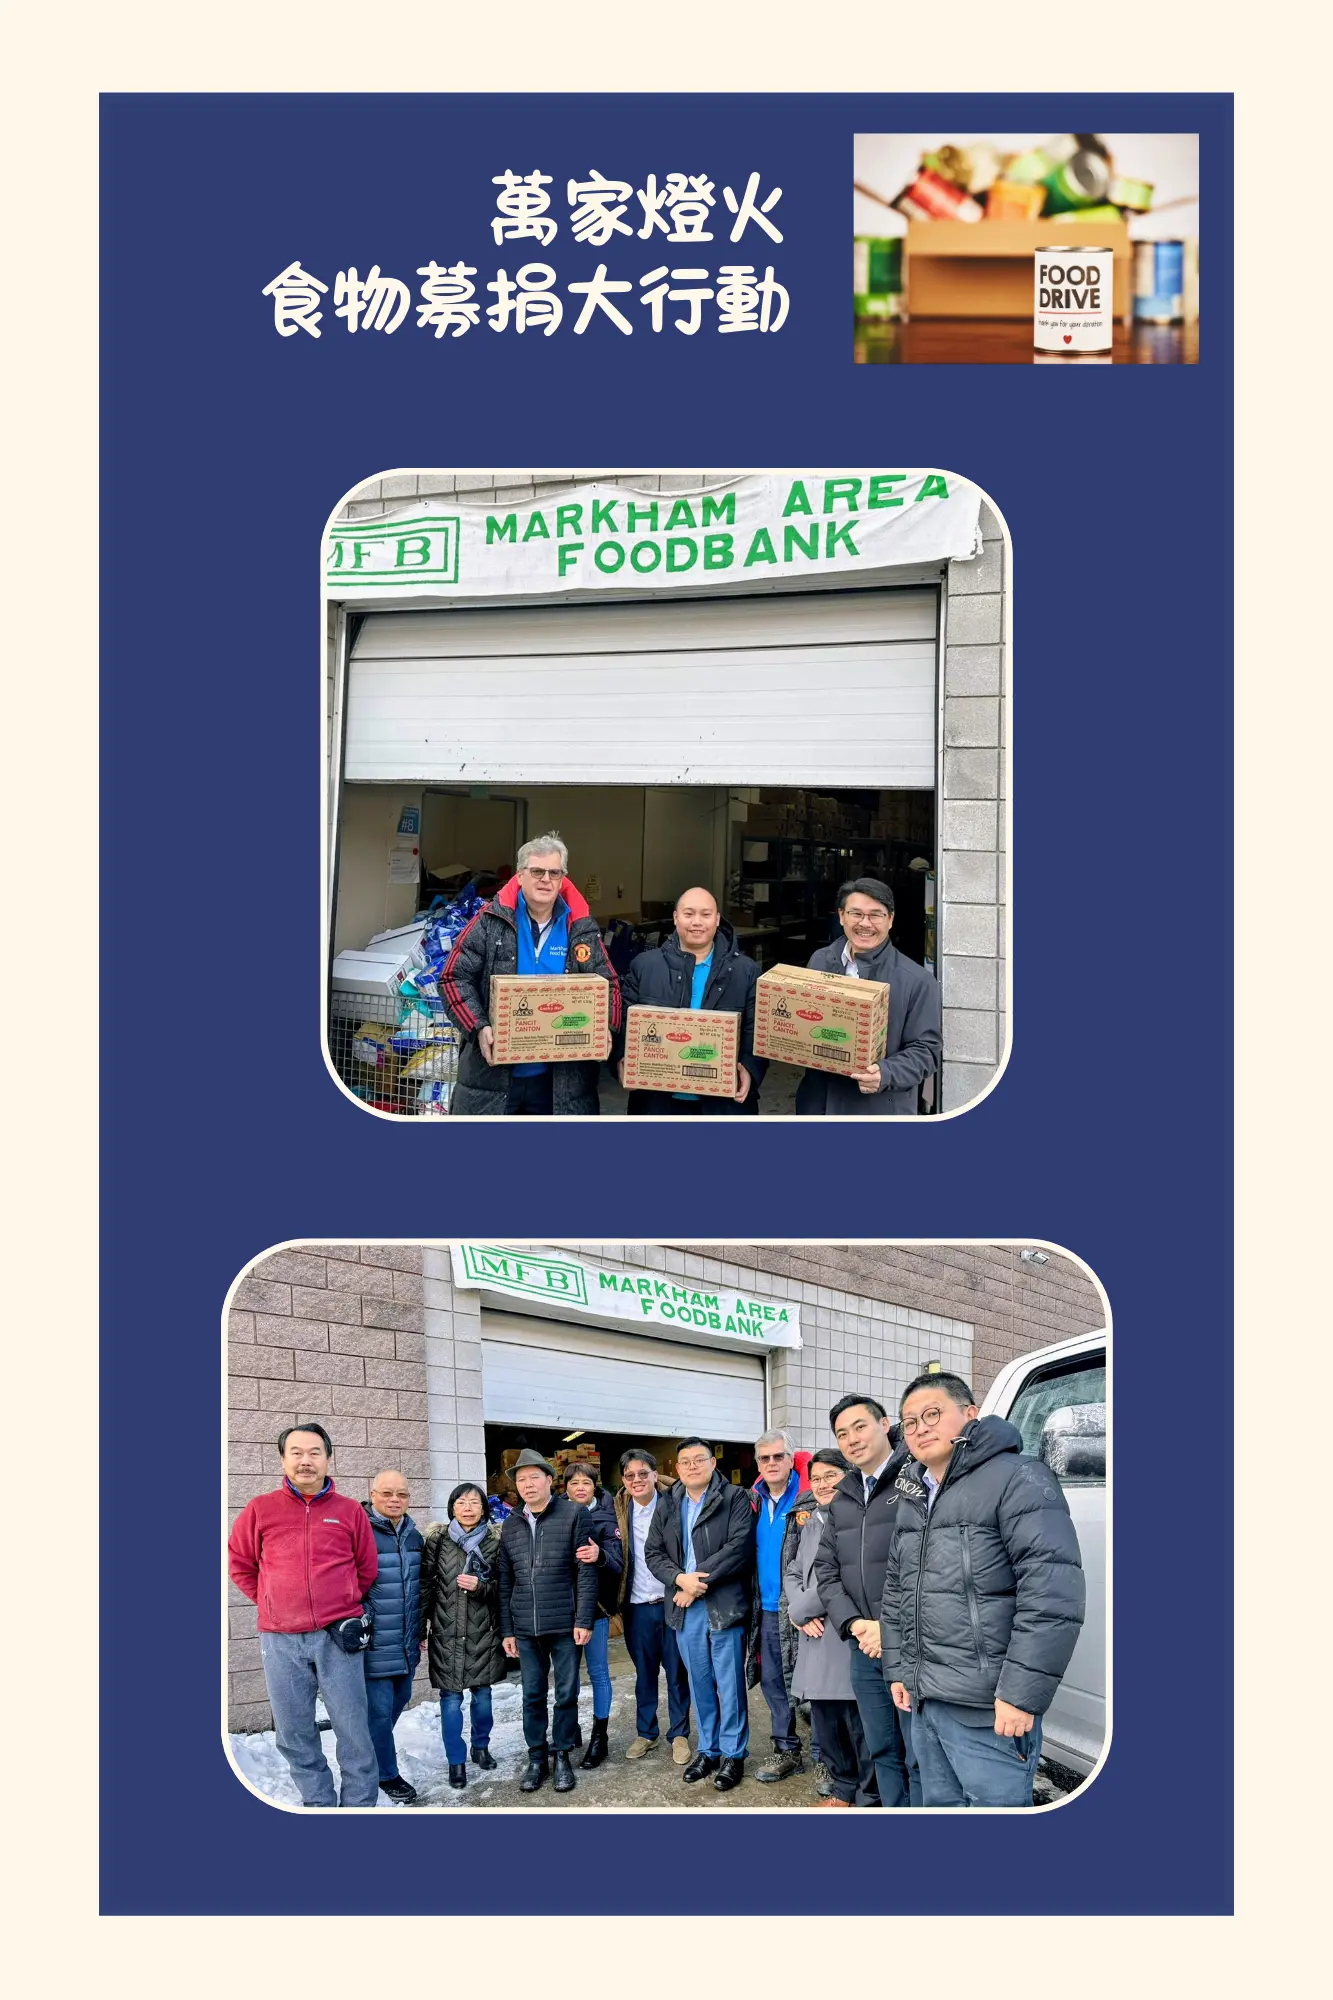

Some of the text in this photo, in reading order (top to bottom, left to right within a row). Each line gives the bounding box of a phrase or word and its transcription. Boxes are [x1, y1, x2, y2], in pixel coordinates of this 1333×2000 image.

[1039, 264, 1101, 286] FOOD
[1039, 287, 1101, 309] DRIVE
[485, 474, 950, 545] MARKHAM AREA
[557, 519, 863, 577] FOODBANK
[401, 818, 414, 832] #8
[519, 996, 529, 1010] 6
[777, 997, 788, 1011] 6
[512, 1009, 534, 1017] PACKS
[771, 1008, 792, 1019] PACKS
[647, 1023, 657, 1036] 6
[773, 1019, 796, 1030] PANCIT
[773, 1025, 799, 1036] CANTON
[480, 1255, 570, 1290] MFB
[599, 1272, 789, 1323] MARKHAM AREA
[641, 1298, 765, 1338] FOODBANK
